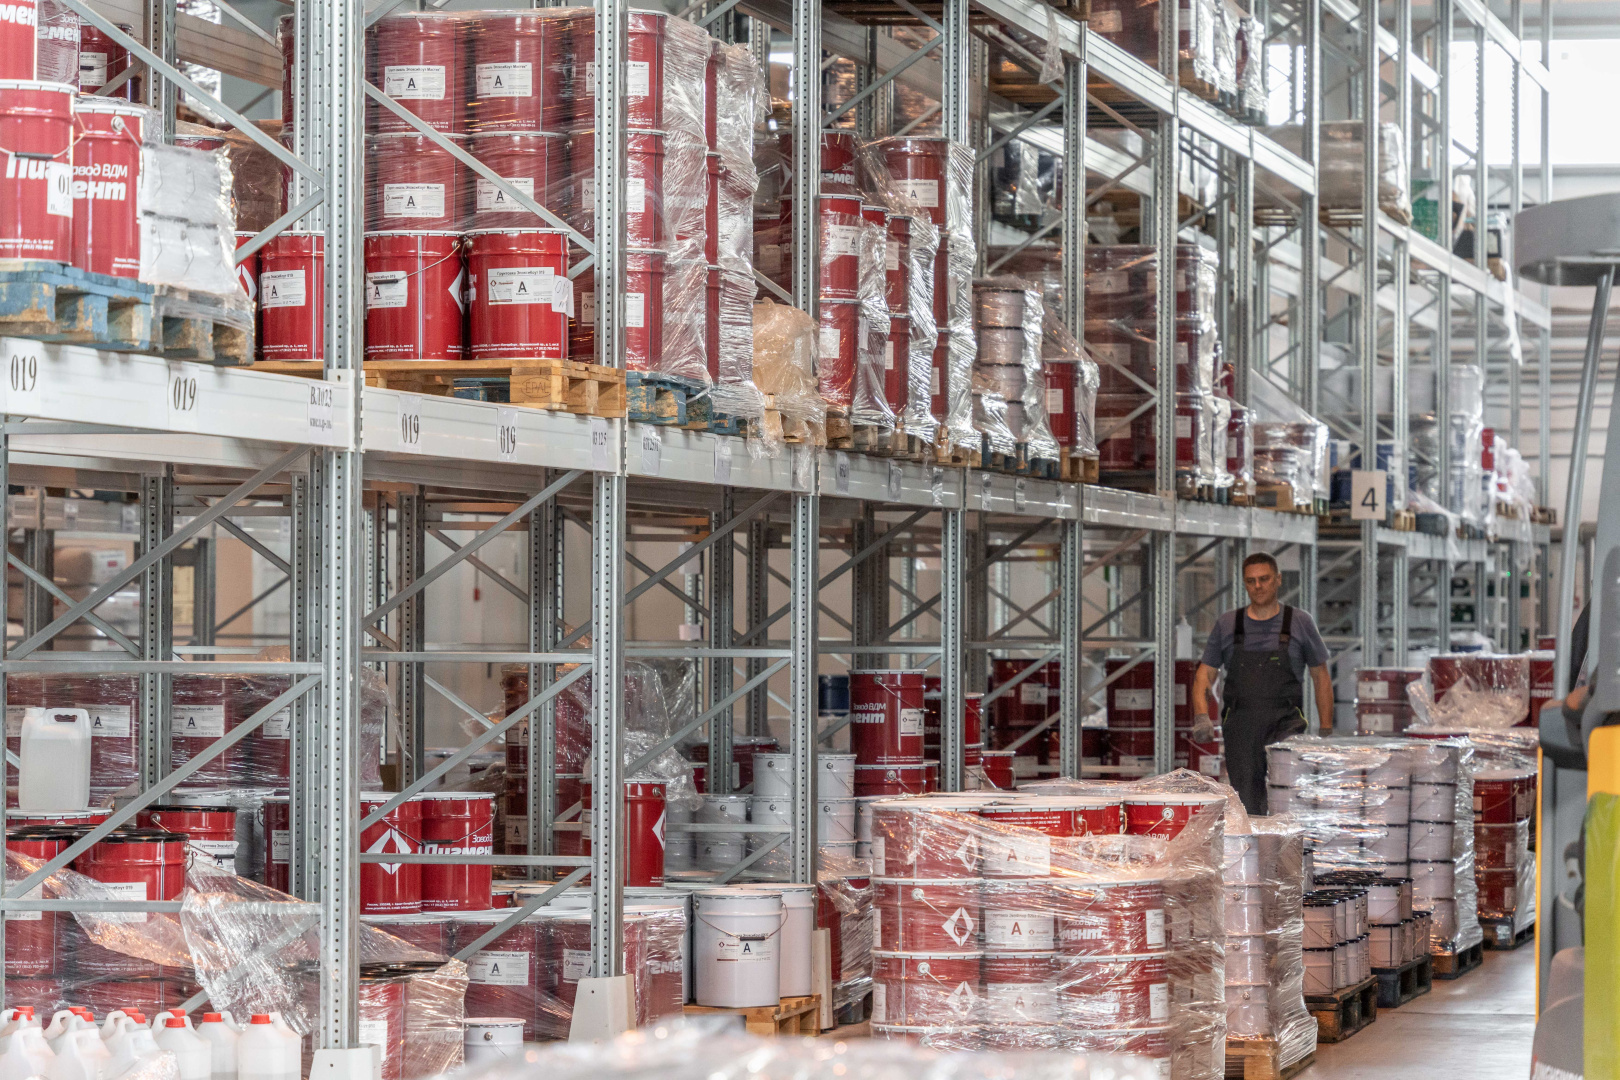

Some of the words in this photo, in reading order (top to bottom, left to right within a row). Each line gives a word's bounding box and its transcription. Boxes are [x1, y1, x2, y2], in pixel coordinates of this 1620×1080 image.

[102, 163, 128, 179] ВДМ
[10, 354, 37, 392] 019
[173, 376, 197, 411] 019
[525, 381, 550, 394] EPAL
[401, 413, 420, 444] 019
[500, 425, 517, 454] 019
[1361, 487, 1379, 512] 4
[869, 702, 887, 711] ВДМ
